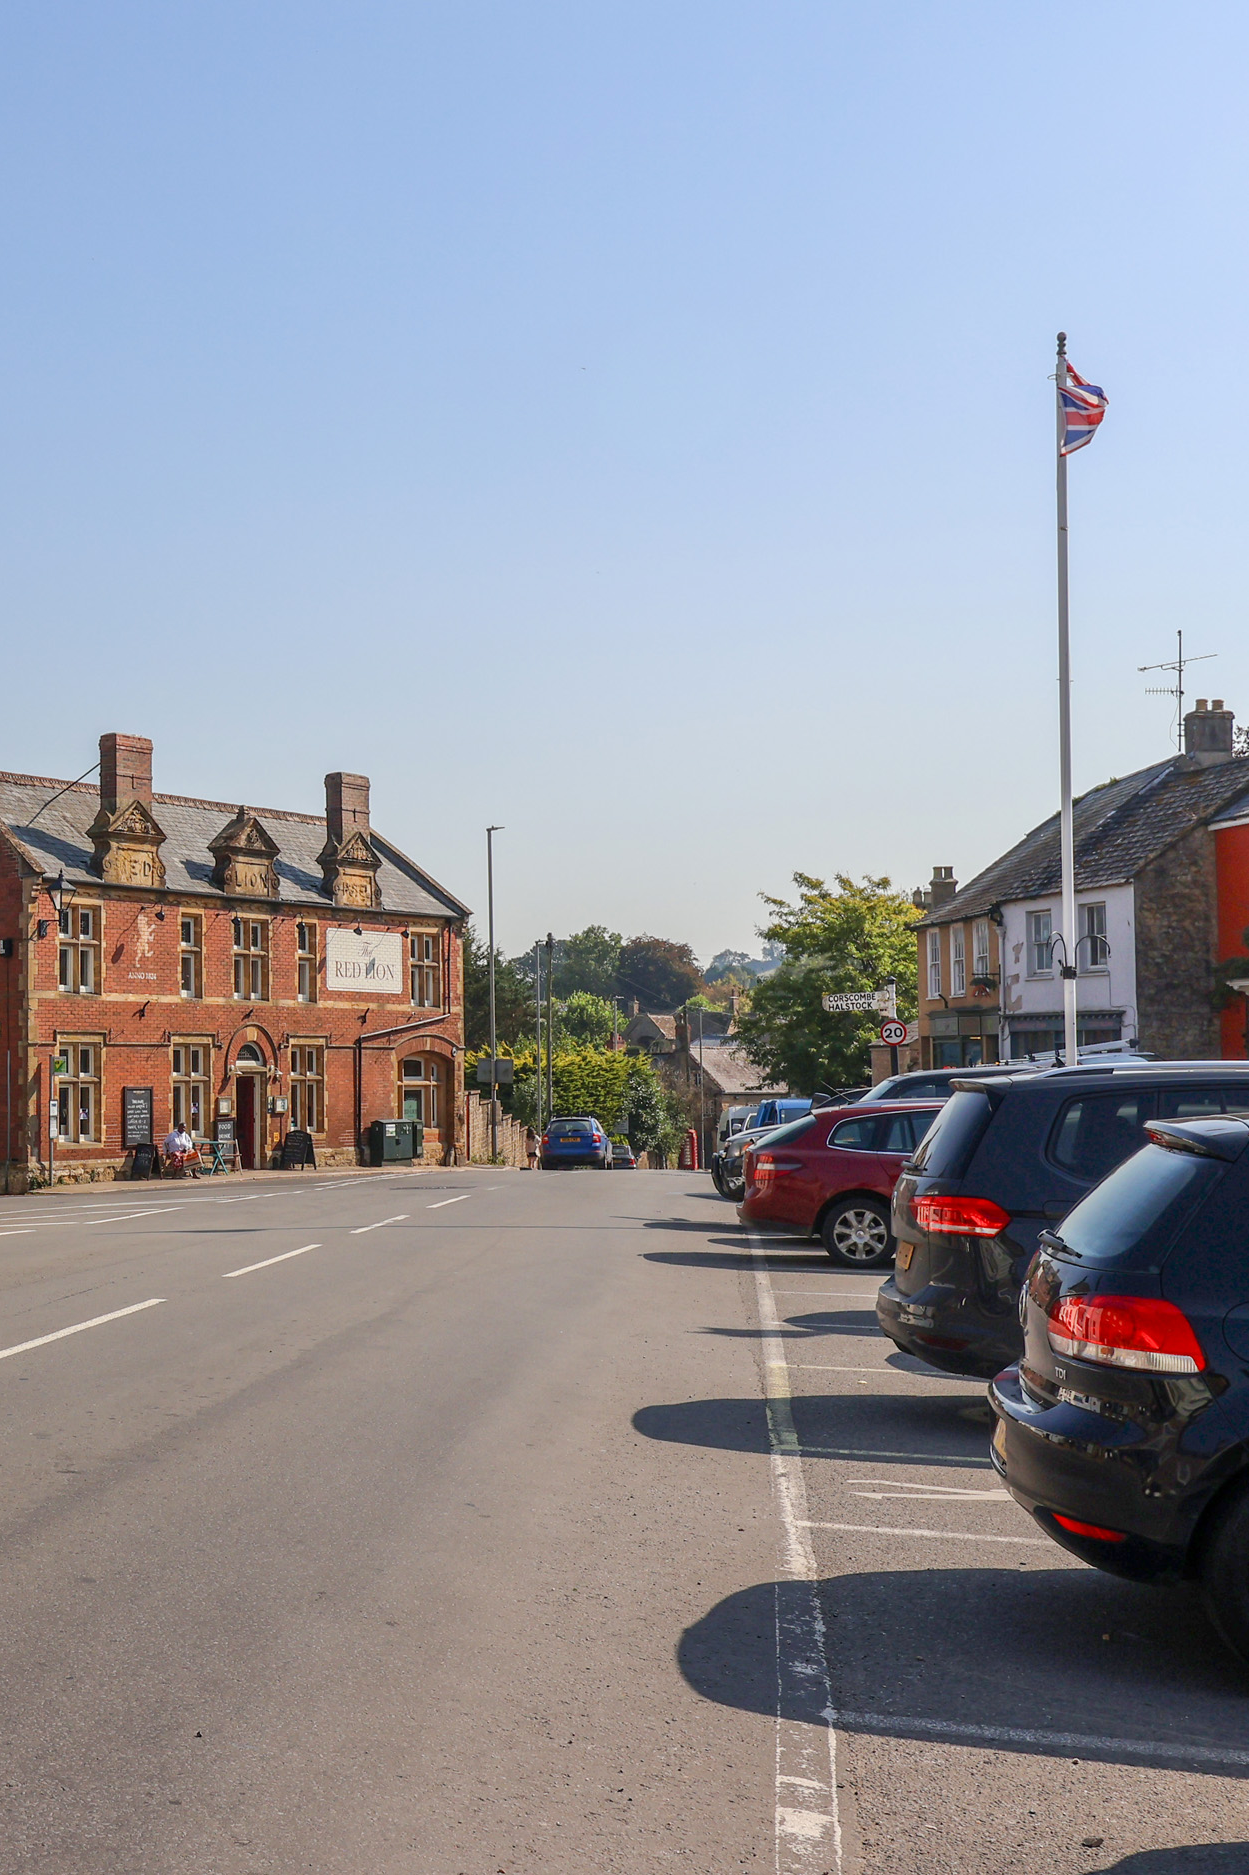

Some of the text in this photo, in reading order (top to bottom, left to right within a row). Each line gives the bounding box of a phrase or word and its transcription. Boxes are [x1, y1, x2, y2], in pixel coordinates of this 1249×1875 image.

[235, 871, 268, 888] LION
[128, 971, 145, 980] ANNO
[335, 961, 395, 980] RED LION
[828, 993, 876, 1002] CORSCOMBE
[828, 1001, 873, 1011] HALSTOCK
[884, 1027, 903, 1039] 20
[1055, 1366, 1066, 1380] TDI
